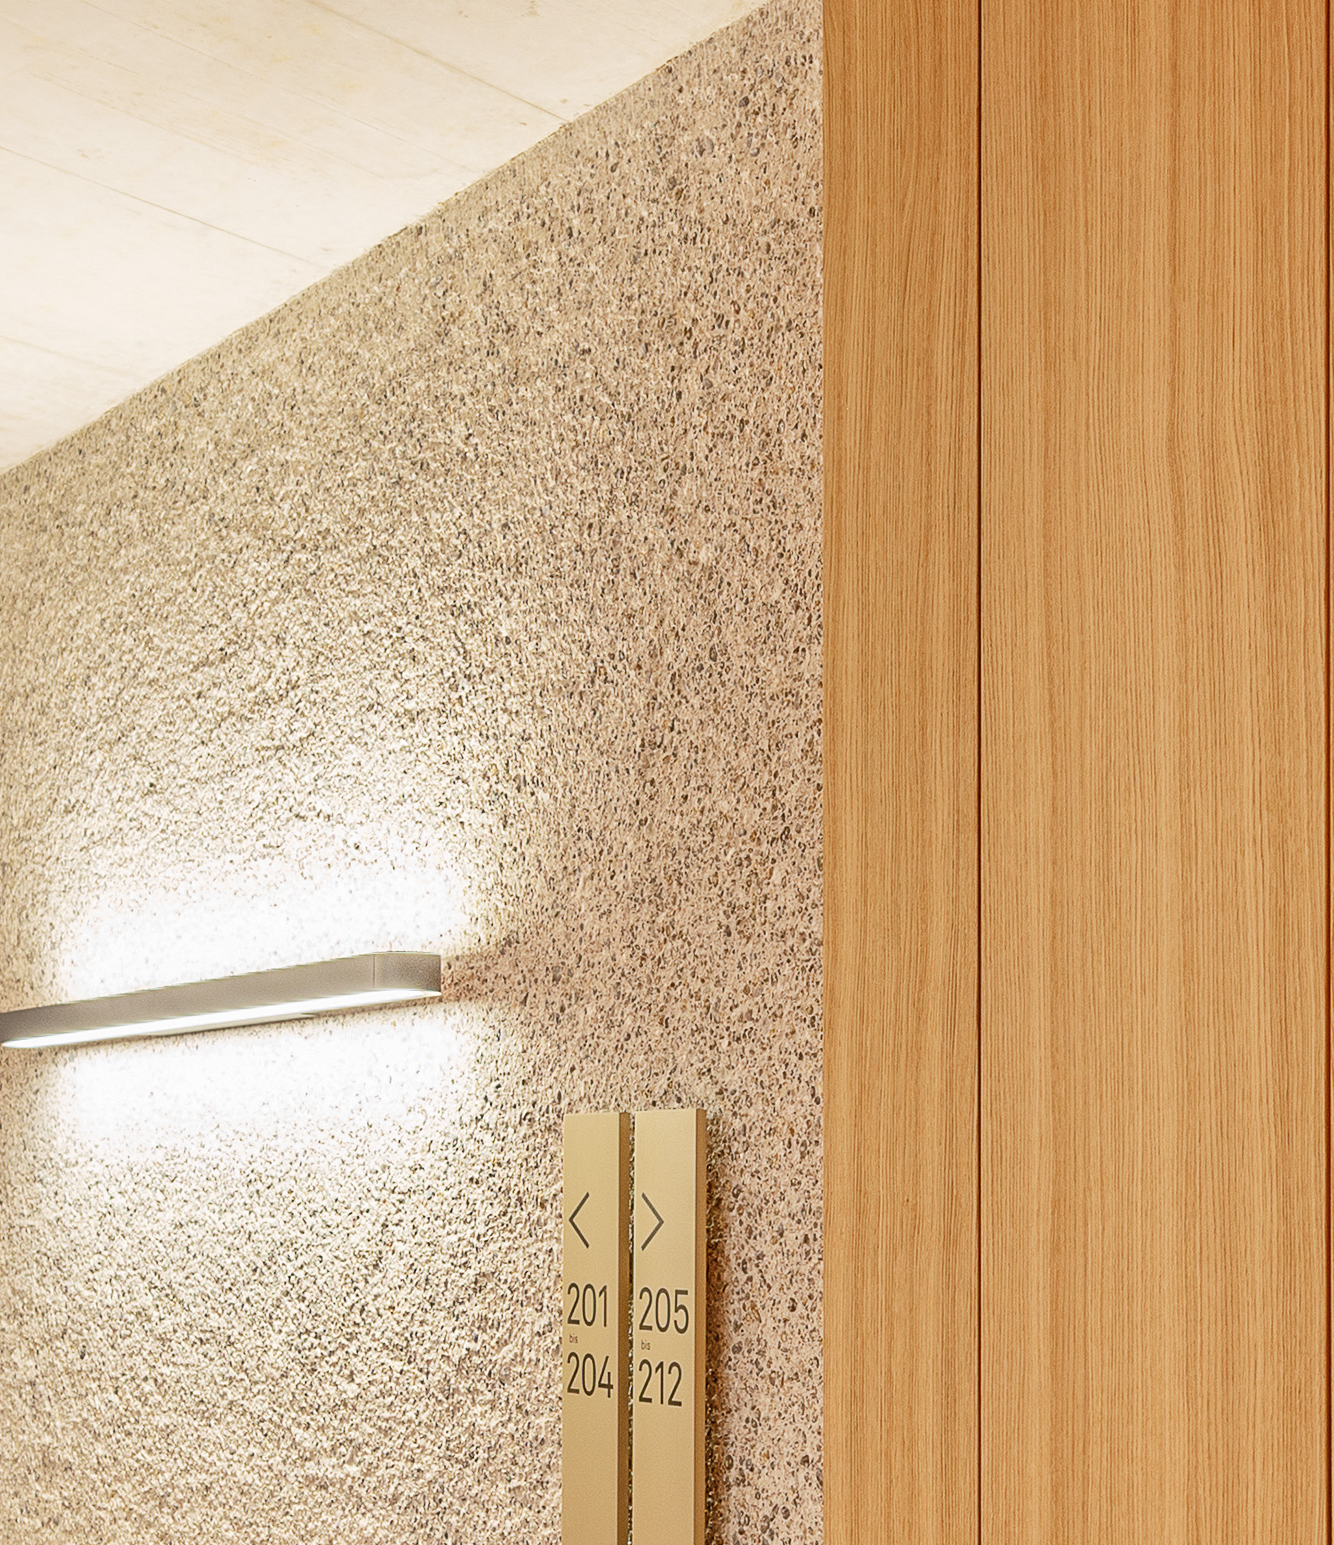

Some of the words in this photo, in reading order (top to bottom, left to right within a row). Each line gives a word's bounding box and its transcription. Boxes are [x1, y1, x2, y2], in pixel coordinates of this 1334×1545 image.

[567, 1282, 608, 1328] 201
[639, 1286, 689, 1334] 205
[569, 1333, 579, 1344] bis
[640, 1339, 651, 1351] bis
[567, 1351, 614, 1399] 204
[638, 1358, 683, 1407] 212
